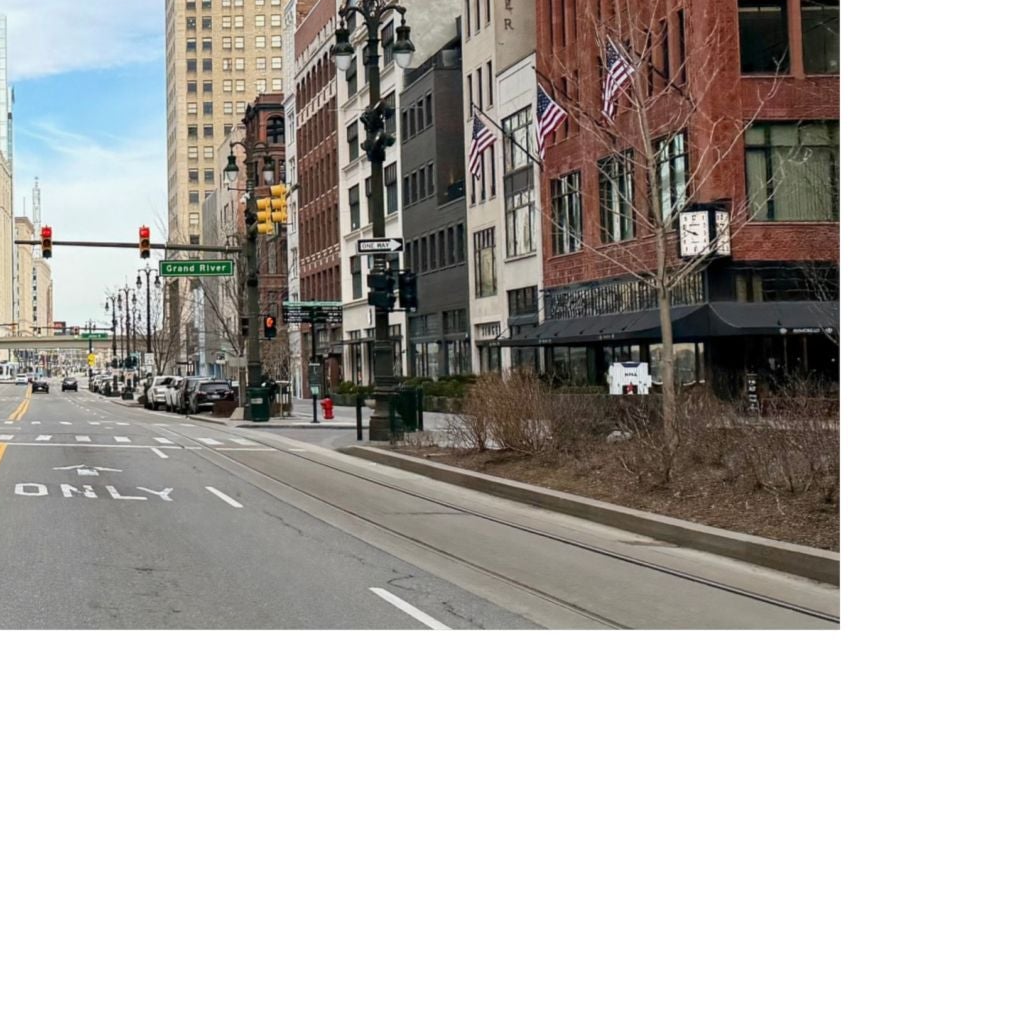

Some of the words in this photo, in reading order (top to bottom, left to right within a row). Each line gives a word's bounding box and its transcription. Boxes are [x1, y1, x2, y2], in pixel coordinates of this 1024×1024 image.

[166, 264, 195, 273] Grand
[199, 264, 227, 272] River
[14, 483, 174, 501] ONLY
